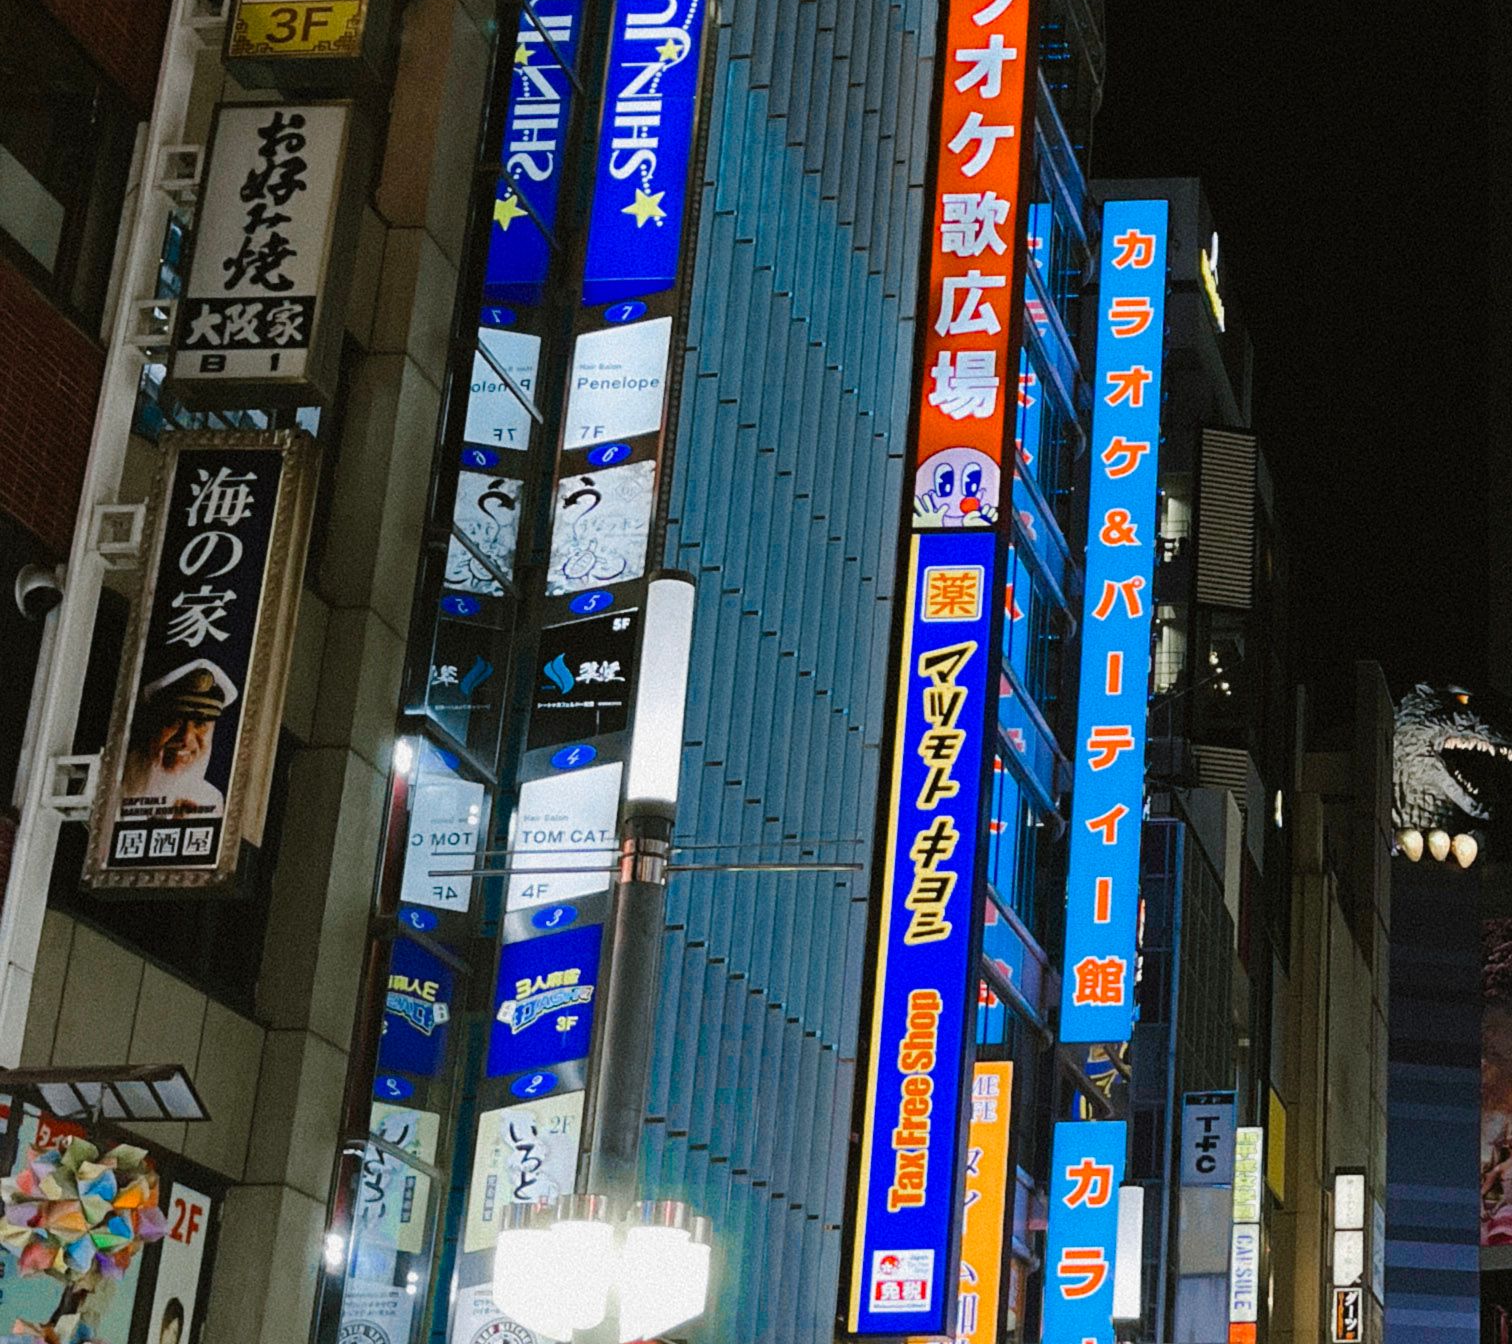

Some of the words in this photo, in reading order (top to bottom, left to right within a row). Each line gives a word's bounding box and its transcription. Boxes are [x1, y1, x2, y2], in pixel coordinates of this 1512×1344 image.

[267, 8, 332, 44] 3F
[223, 112, 306, 293] お好み焼
[187, 302, 305, 346] 大阪家
[577, 375, 659, 392] Penelope
[580, 425, 605, 440] 7F
[165, 467, 255, 648] 海の家
[931, 573, 976, 615] 薬
[613, 618, 631, 631] 5F
[1073, 229, 1157, 1007] カラオケ&パーティー館
[905, 642, 977, 944] マツモトキヨシ
[116, 826, 213, 858] 居酒屋
[523, 829, 564, 845] TOM
[571, 829, 608, 843] CAT
[522, 883, 549, 899] 4F
[900, 989, 942, 1073] Shop
[894, 1074, 934, 1148] Free
[508, 1122, 544, 1199] いろど
[888, 1149, 928, 1212] Tax
[168, 1197, 203, 1245] 2F
